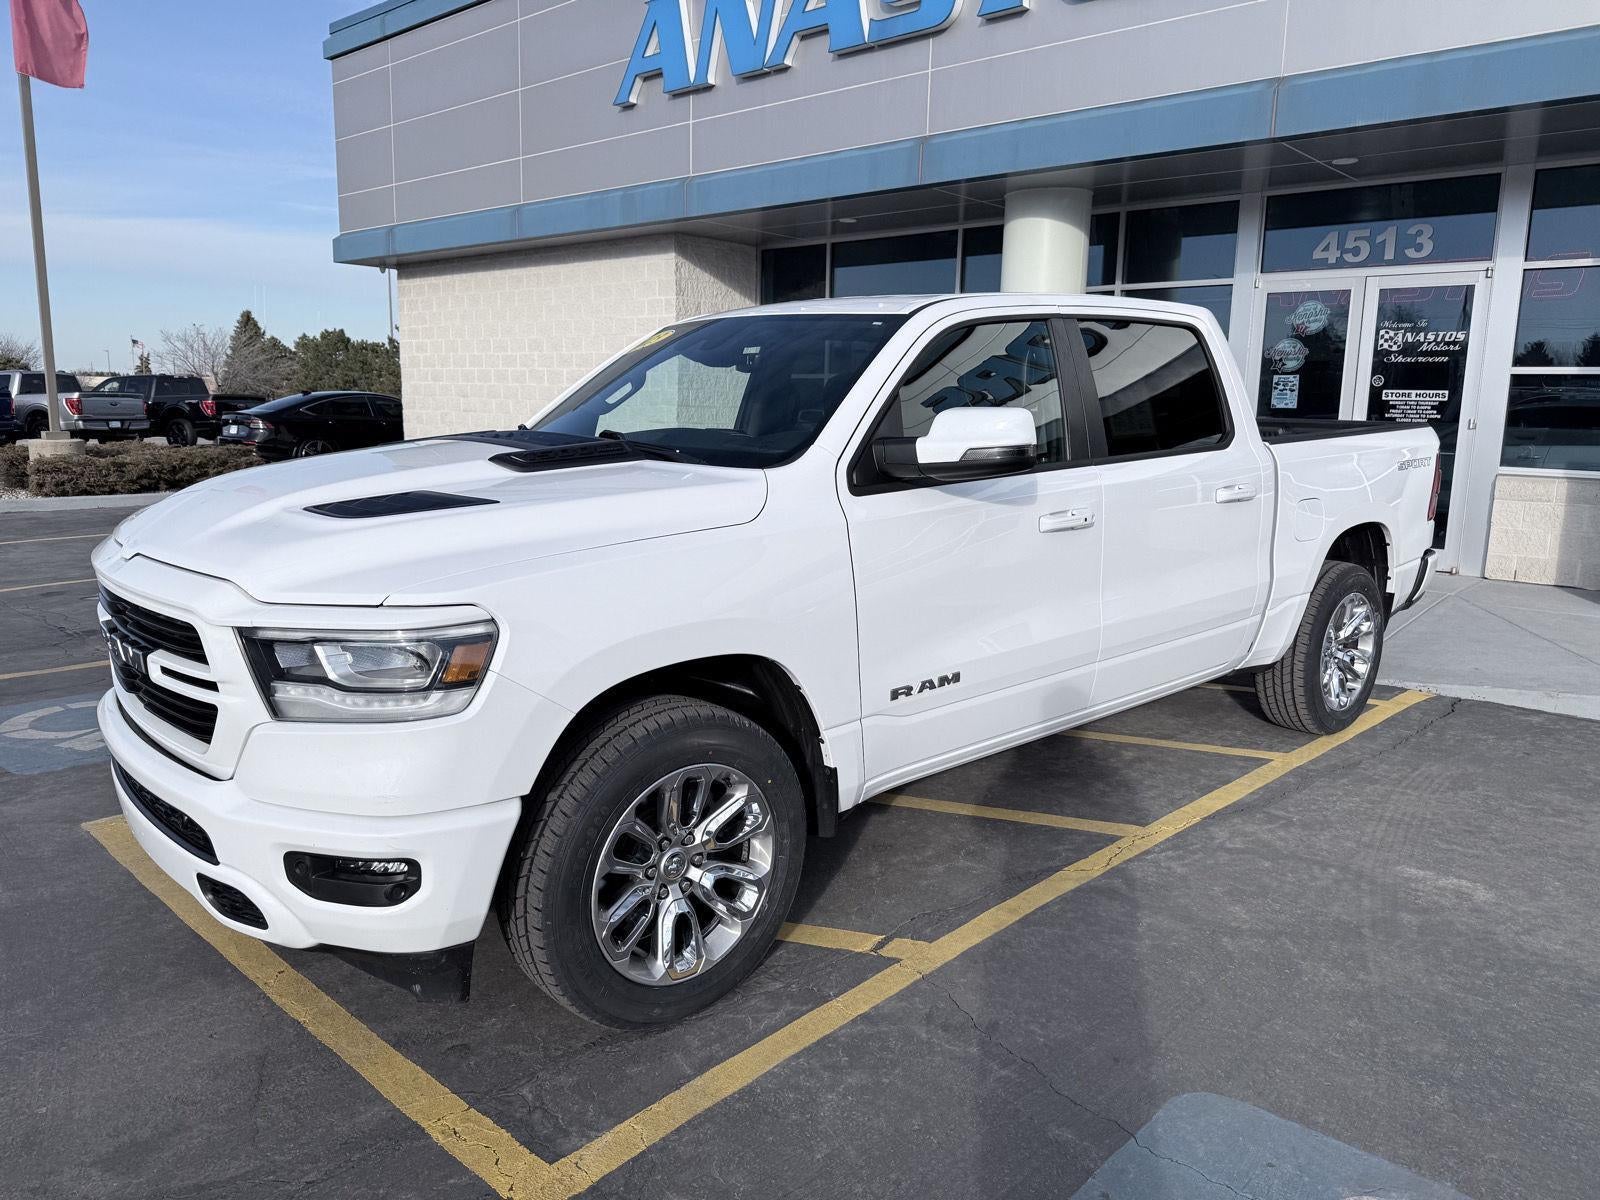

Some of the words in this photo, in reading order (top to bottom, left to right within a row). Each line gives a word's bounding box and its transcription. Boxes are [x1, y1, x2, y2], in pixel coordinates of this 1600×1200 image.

[1311, 223, 1435, 265] 4513
[1380, 320, 1415, 328] Welcome
[1416, 319, 1429, 327] To
[1391, 331, 1467, 343] ANASTOS
[1417, 341, 1462, 352] Motors
[1384, 353, 1449, 363] Showroom
[1384, 391, 1413, 399] STORE
[1397, 456, 1432, 472] SPORT
[890, 671, 961, 702] RAM
